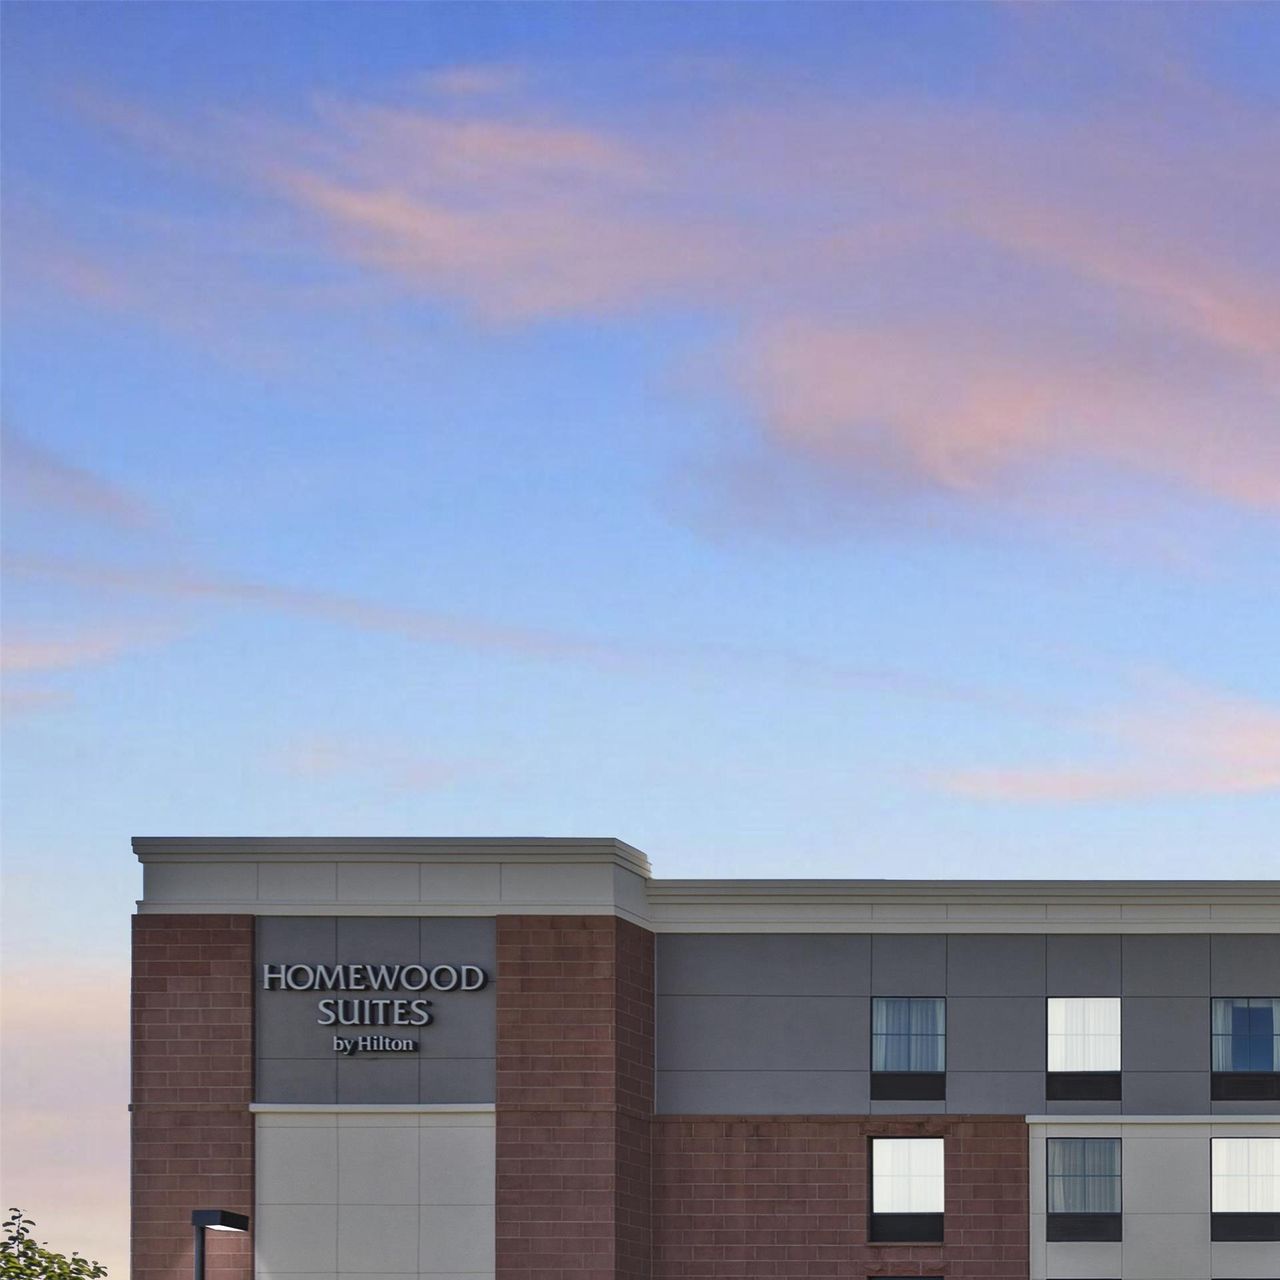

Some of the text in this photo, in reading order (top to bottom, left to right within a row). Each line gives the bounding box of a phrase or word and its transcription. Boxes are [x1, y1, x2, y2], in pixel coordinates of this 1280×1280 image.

[262, 964, 486, 991] HOMEWOOD
[317, 999, 431, 1026] SUITES
[333, 1036, 415, 1055] by Hilton
